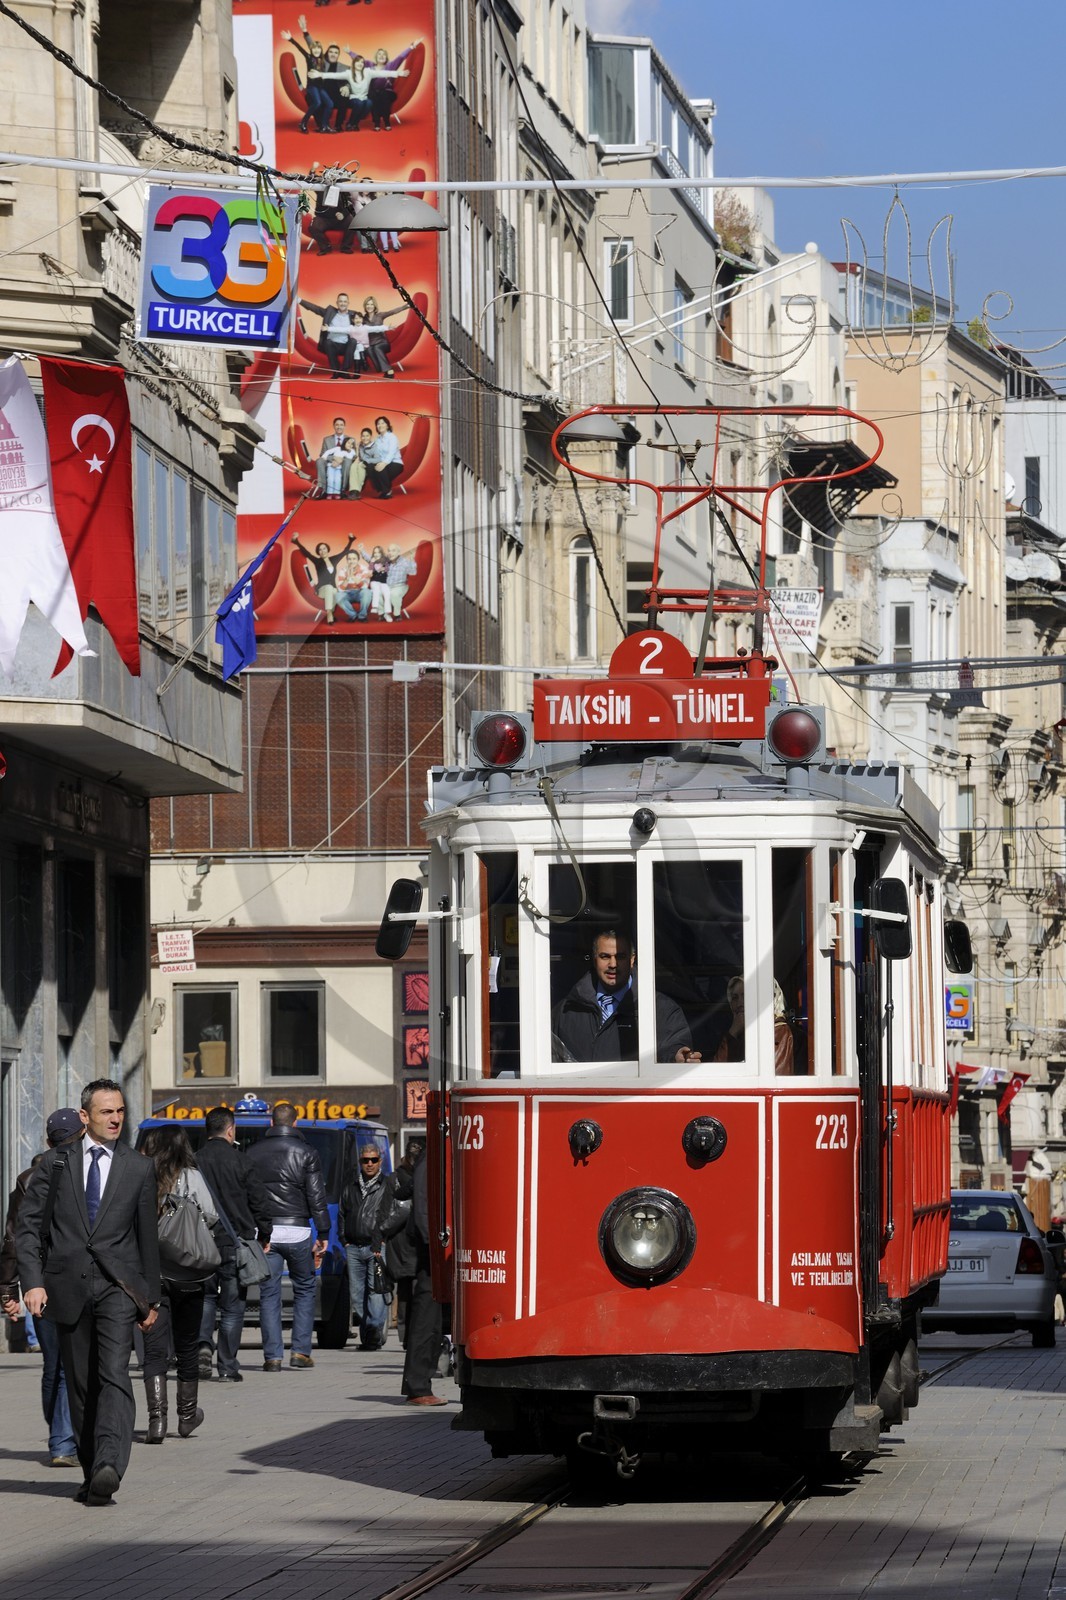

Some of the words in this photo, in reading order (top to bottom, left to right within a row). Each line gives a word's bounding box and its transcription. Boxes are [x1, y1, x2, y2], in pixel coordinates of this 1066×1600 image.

[152, 195, 287, 304] 3G
[153, 306, 276, 337] TURKCELL
[794, 618, 817, 628] CAFE
[639, 637, 664, 675] 2
[545, 689, 631, 725] TAKSİM
[672, 688, 754, 724] TÜNEL
[161, 939, 190, 947] TRAMVAY
[162, 964, 194, 973] ODAKULE
[457, 1114, 484, 1150] 223
[815, 1114, 848, 1150] 223
[477, 1250, 506, 1265] YASAK
[791, 1252, 832, 1267] ASILMAK
[969, 1260, 981, 1271] 01
[791, 1271, 805, 1286] VE
